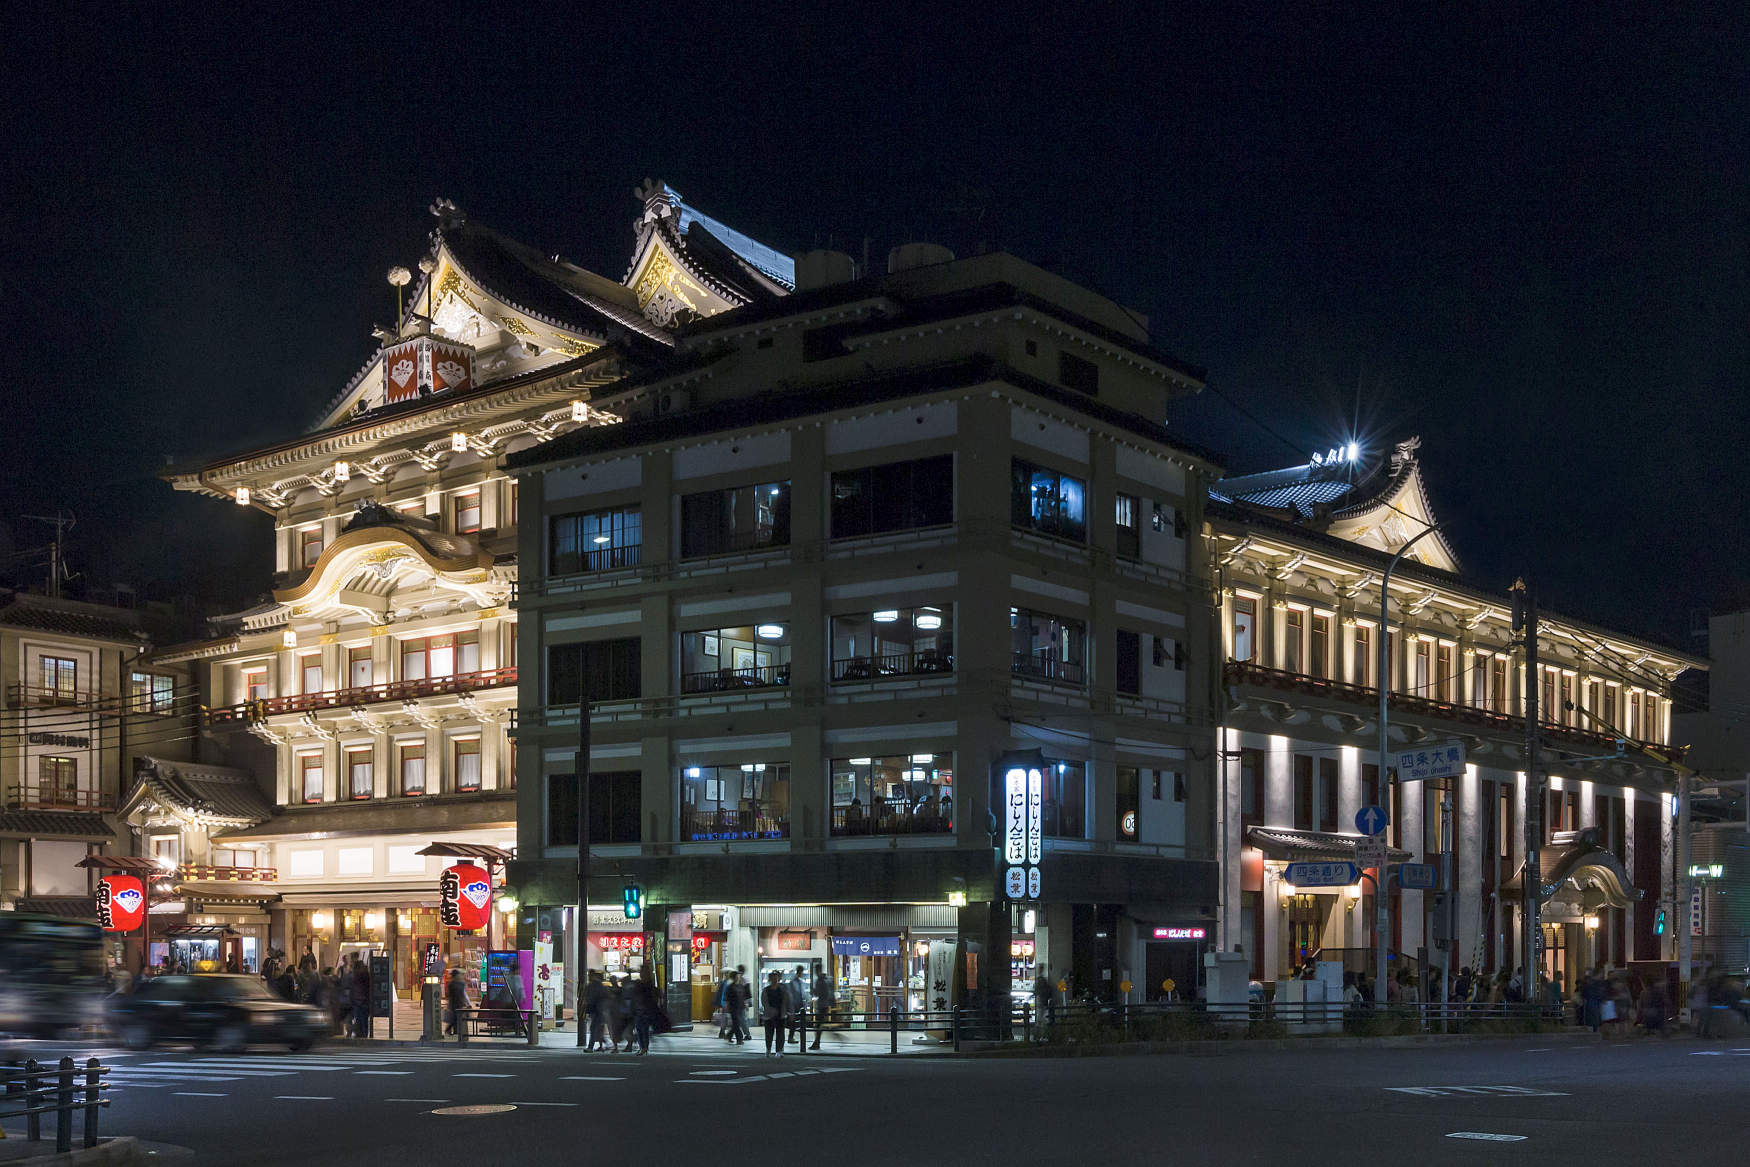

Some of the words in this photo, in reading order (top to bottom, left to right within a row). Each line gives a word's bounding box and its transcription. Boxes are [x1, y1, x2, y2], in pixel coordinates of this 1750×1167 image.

[1401, 747, 1459, 768] 四条大橋
[1009, 793, 1023, 859] にしんそば
[1030, 793, 1039, 859] にしんそば
[1010, 870, 1022, 894] 松葉
[1030, 870, 1038, 894] 松葉
[1296, 865, 1345, 877] 四条通り
[932, 979, 947, 1010] 松葉
